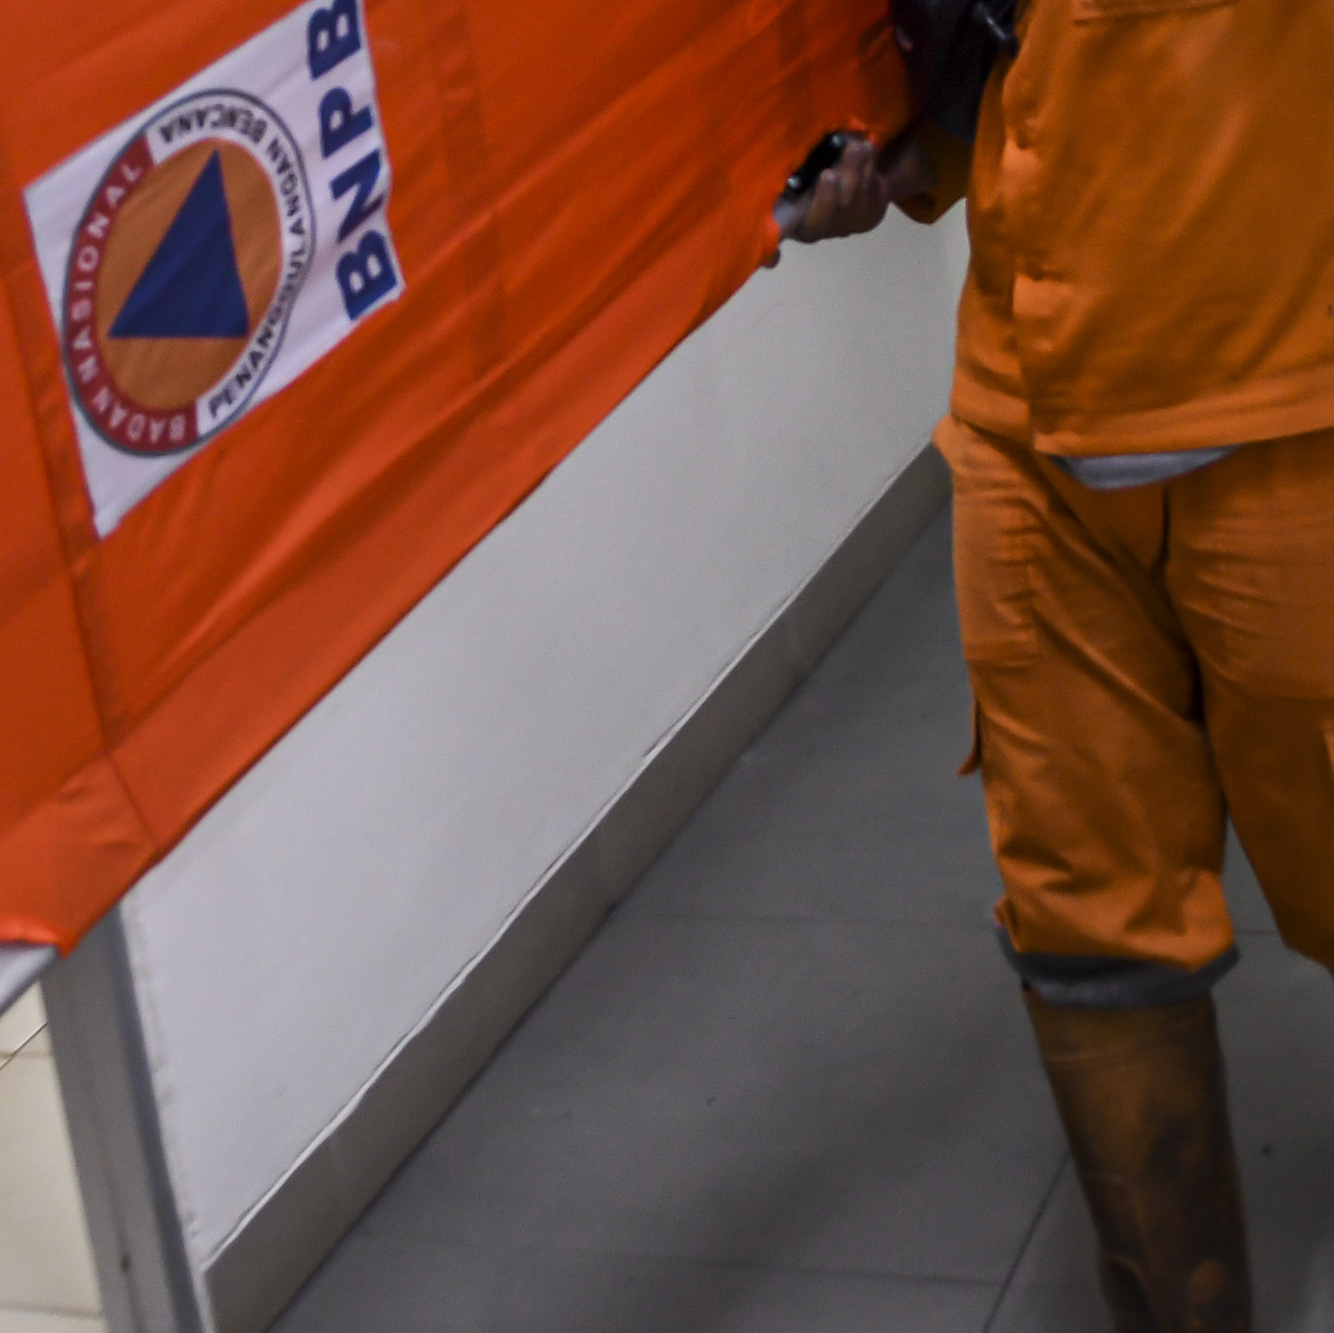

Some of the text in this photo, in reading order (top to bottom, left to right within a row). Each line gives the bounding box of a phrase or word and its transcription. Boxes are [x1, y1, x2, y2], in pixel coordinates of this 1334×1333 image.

[159, 102, 269, 145] BENCANA
[70, 161, 187, 444] BADAN NASIONAL
